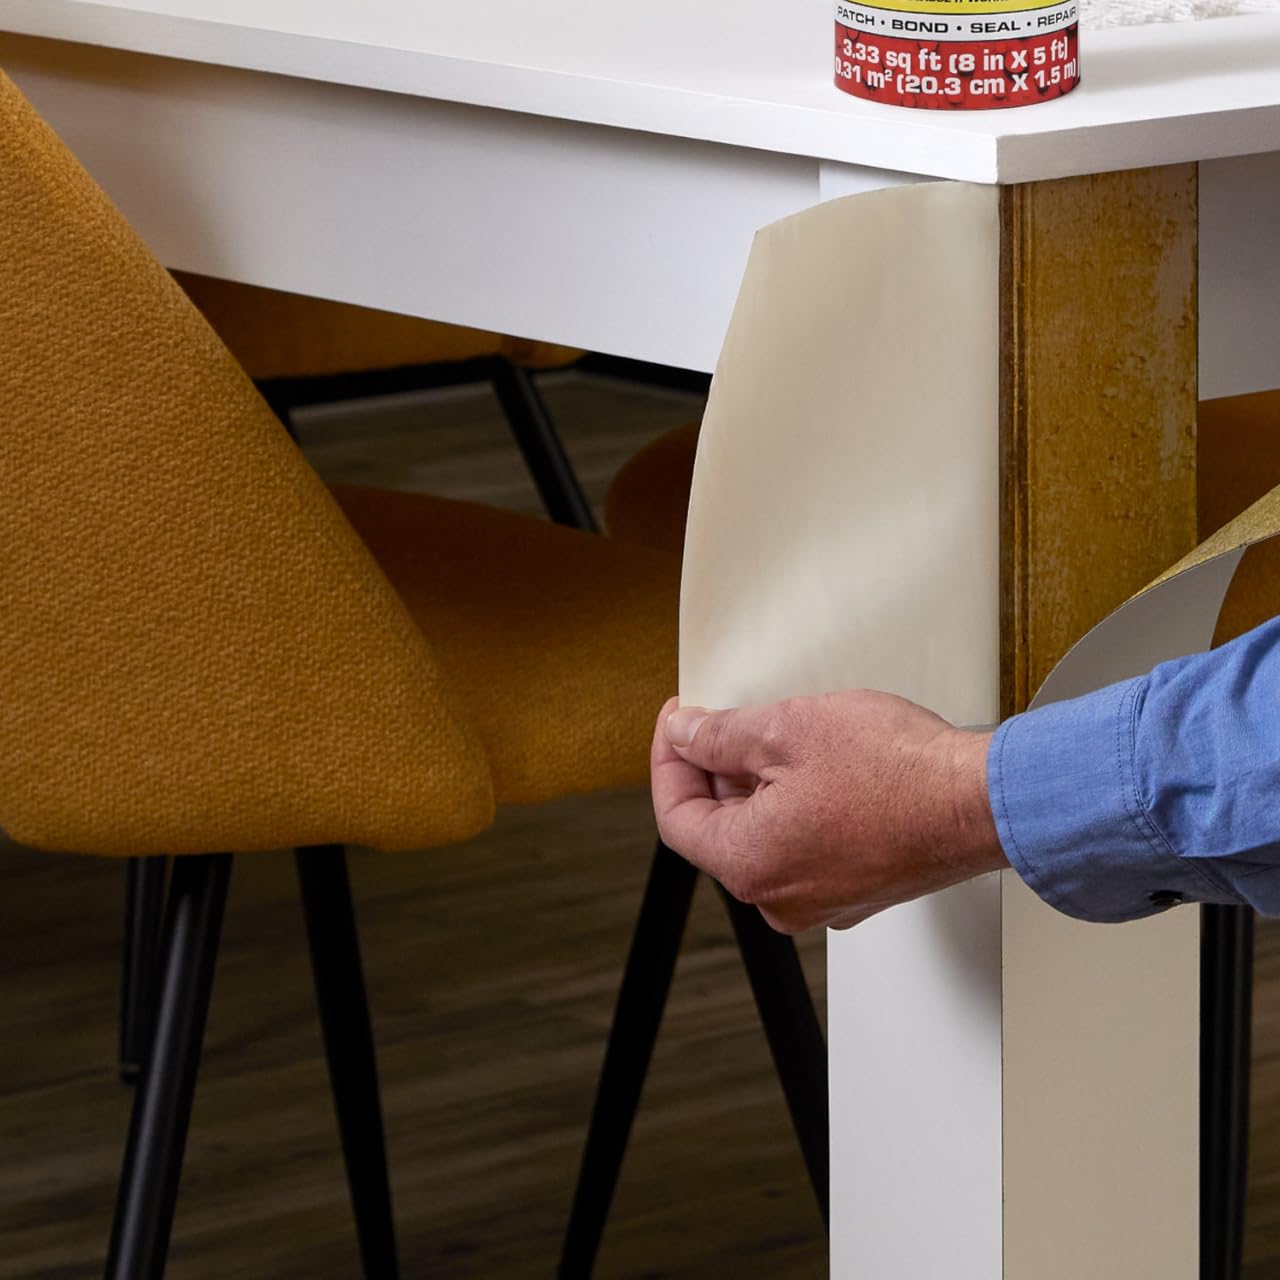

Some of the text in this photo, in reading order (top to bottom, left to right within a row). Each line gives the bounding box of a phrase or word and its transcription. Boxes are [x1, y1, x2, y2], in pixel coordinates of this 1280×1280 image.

[837, 5, 876, 26] PATCH
[891, 19, 949, 34] BOND
[970, 20, 1021, 33] SEAL
[842, 36, 1068, 75] 3.33 sq ft (8 in X 5 ft)
[834, 56, 862, 83] 0.31
[896, 74, 962, 96] (20.3
[969, 77, 1006, 95] cm
[1011, 73, 1030, 92] X
[1034, 65, 1061, 88] 1.5
[1063, 57, 1077, 80] m)
